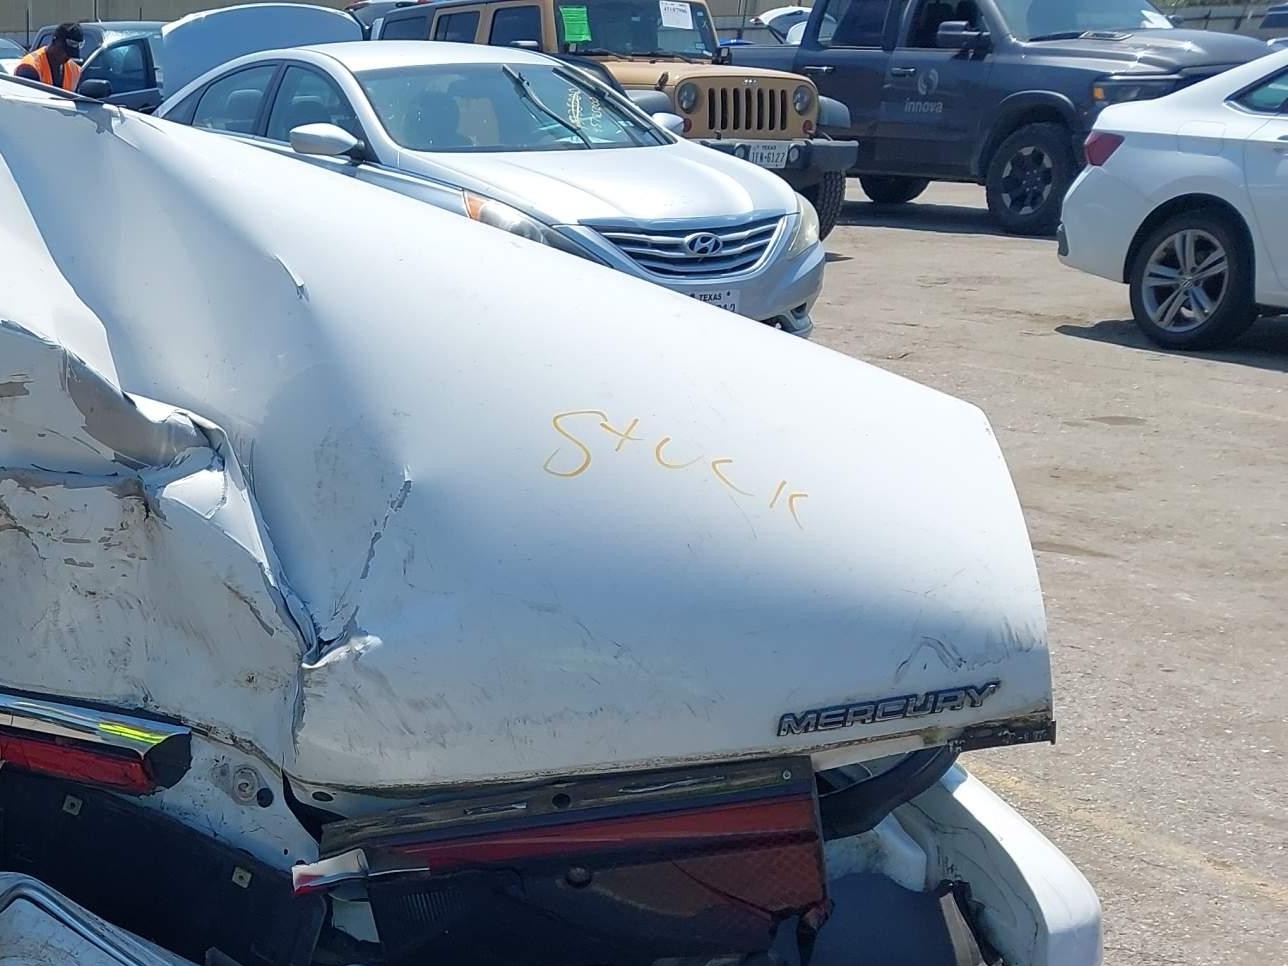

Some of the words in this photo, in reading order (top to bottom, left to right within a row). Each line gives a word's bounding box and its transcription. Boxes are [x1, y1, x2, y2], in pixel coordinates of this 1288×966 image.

[904, 97, 943, 113] innova
[699, 293, 722, 302] TEXAS
[776, 677, 1002, 737] MERCURY
